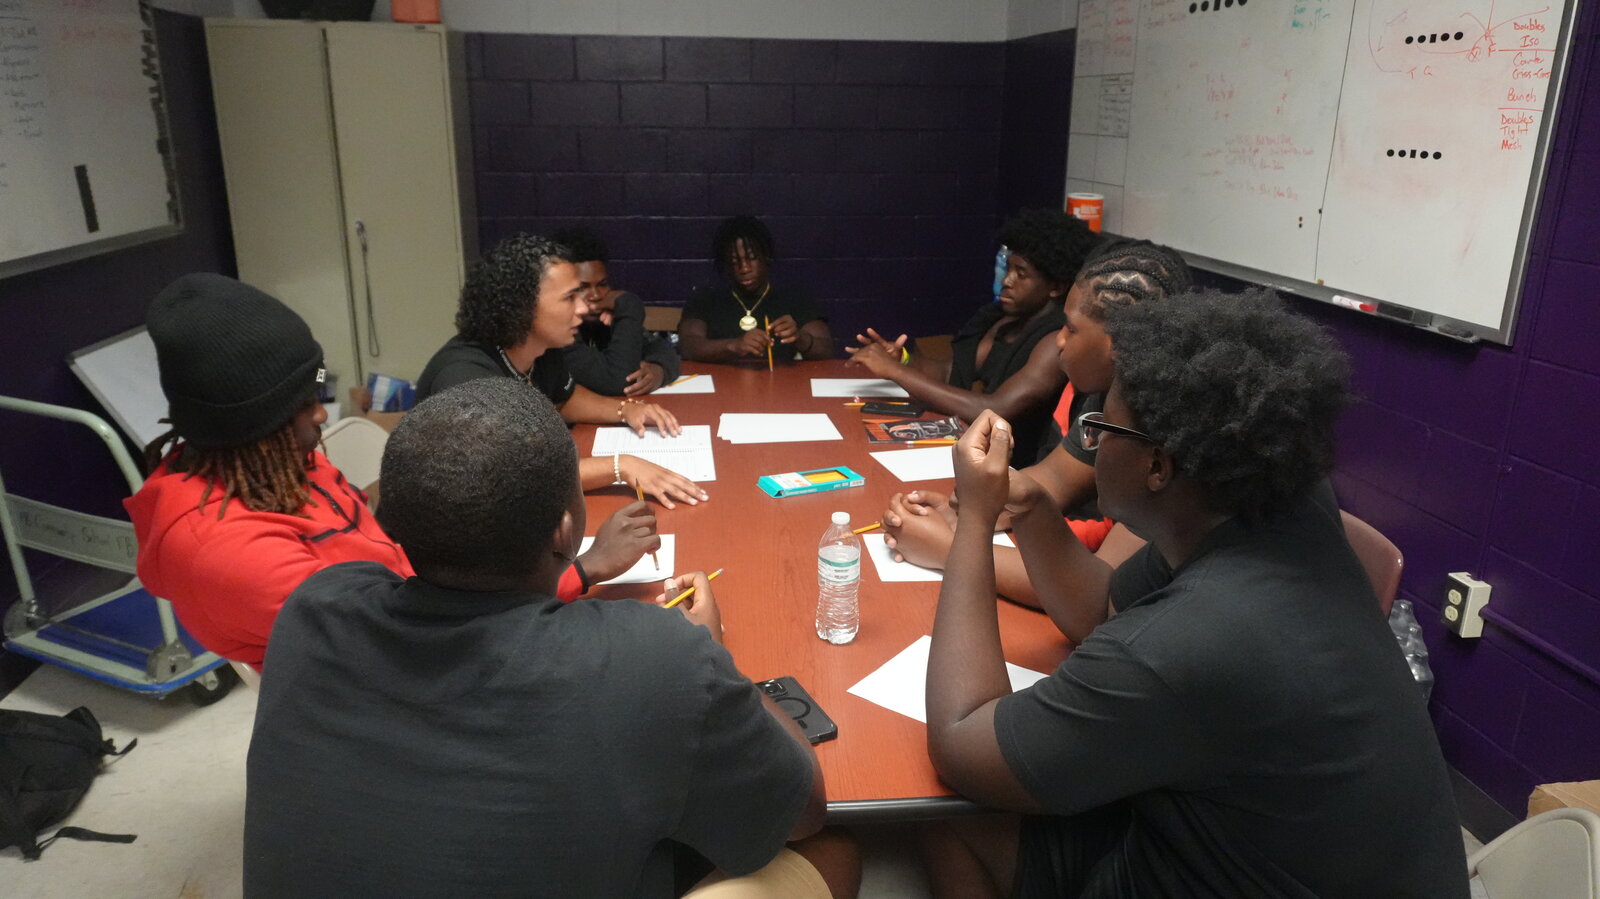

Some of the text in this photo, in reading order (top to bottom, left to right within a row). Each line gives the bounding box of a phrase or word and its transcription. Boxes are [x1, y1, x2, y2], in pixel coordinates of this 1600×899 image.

[1513, 17, 1545, 32] Doubles
[1520, 35, 1539, 47] Iso
[1501, 111, 1534, 125] Doubles
